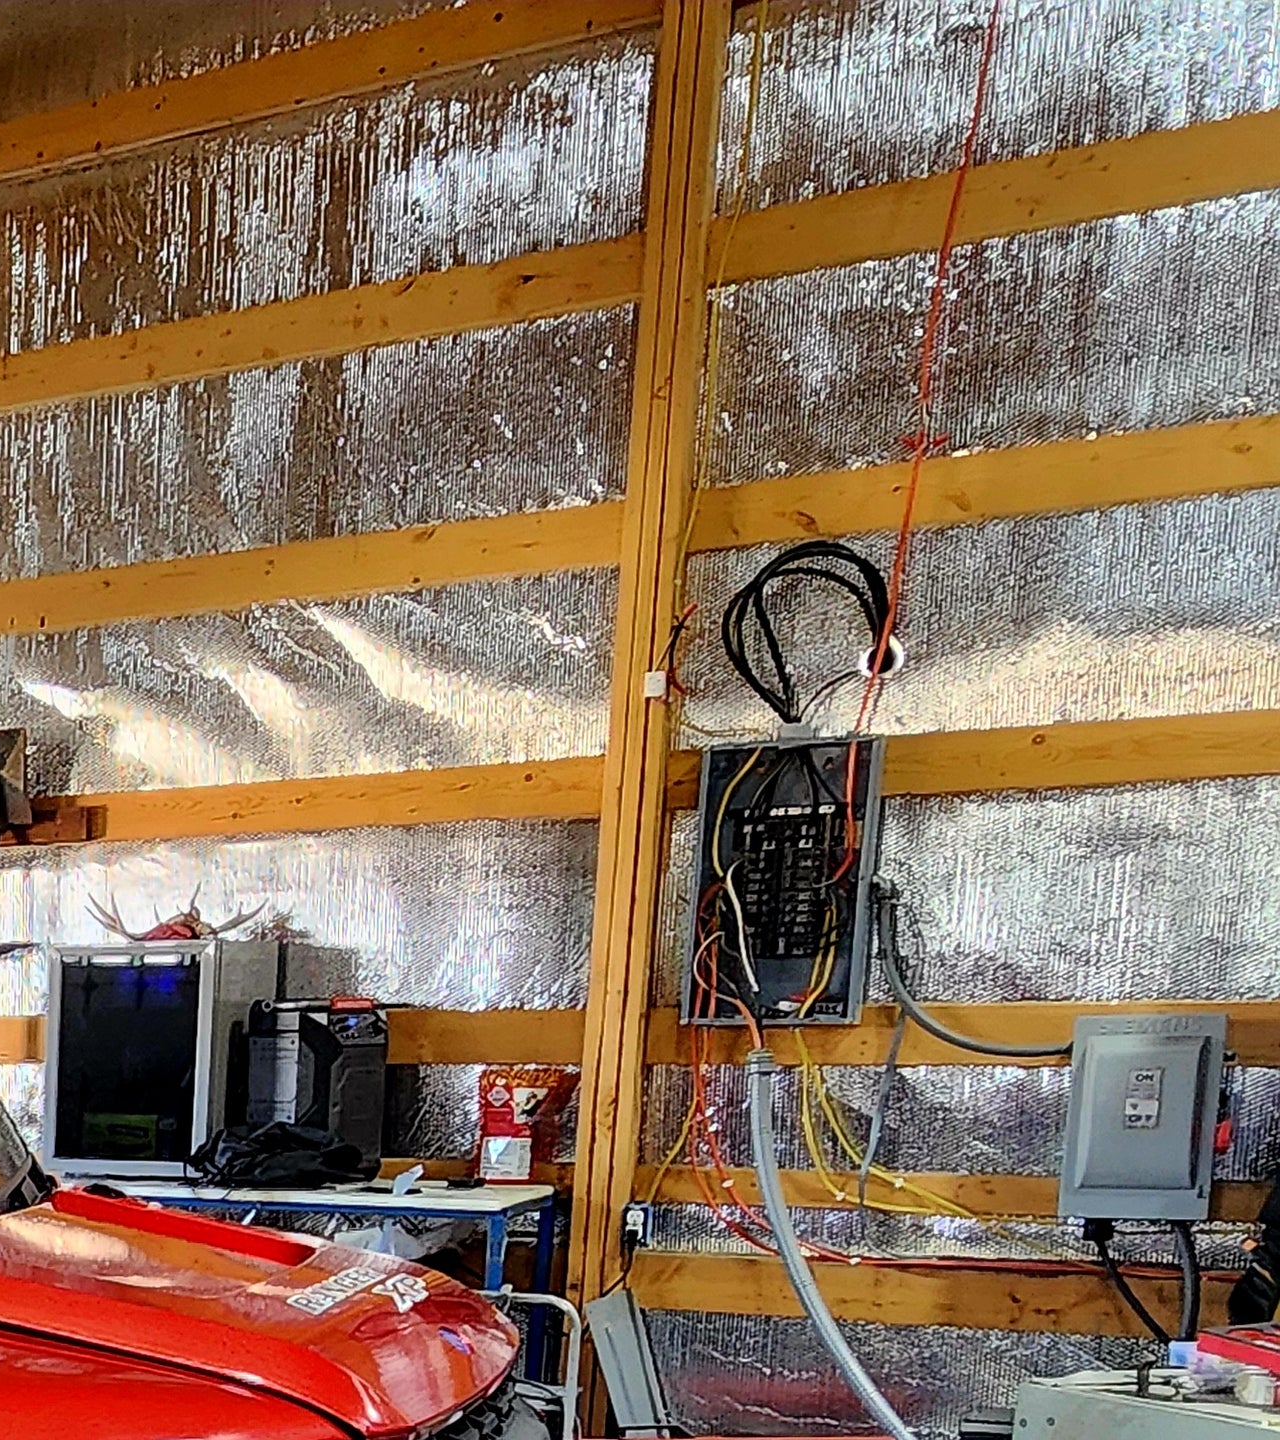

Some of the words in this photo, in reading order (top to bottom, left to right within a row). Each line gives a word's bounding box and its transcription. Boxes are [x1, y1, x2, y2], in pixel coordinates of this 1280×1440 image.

[1135, 1073, 1155, 1082] ON
[286, 1266, 388, 1316] RANGER
[371, 1272, 430, 1314] XP
